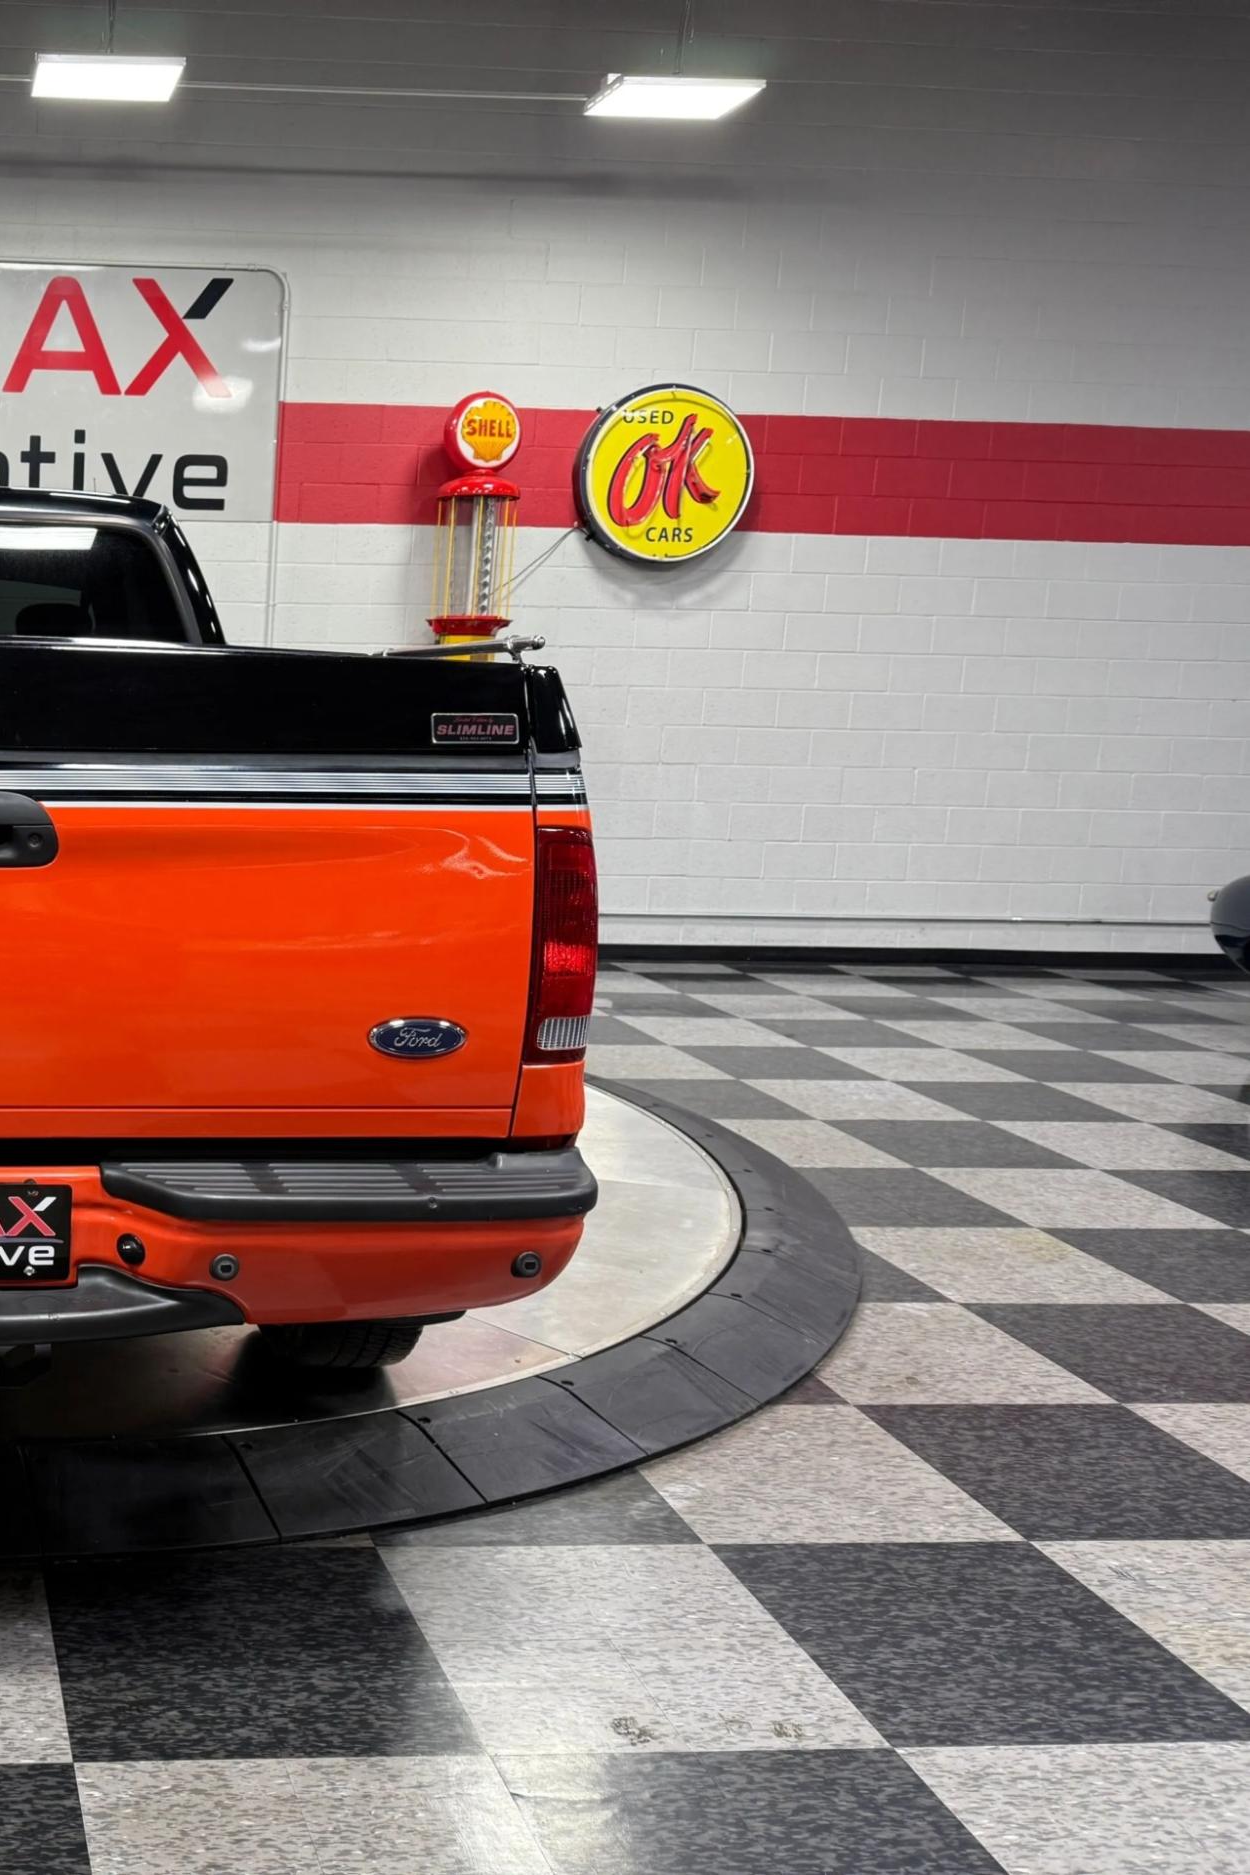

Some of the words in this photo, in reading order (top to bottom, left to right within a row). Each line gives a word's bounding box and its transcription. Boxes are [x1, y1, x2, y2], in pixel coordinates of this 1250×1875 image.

[623, 408, 674, 425] USED
[465, 417, 513, 439] SHELL
[608, 413, 721, 527] OK
[645, 527, 694, 544] CARS
[436, 724, 515, 736] SLIMLINE
[394, 1027, 444, 1048] Ford
